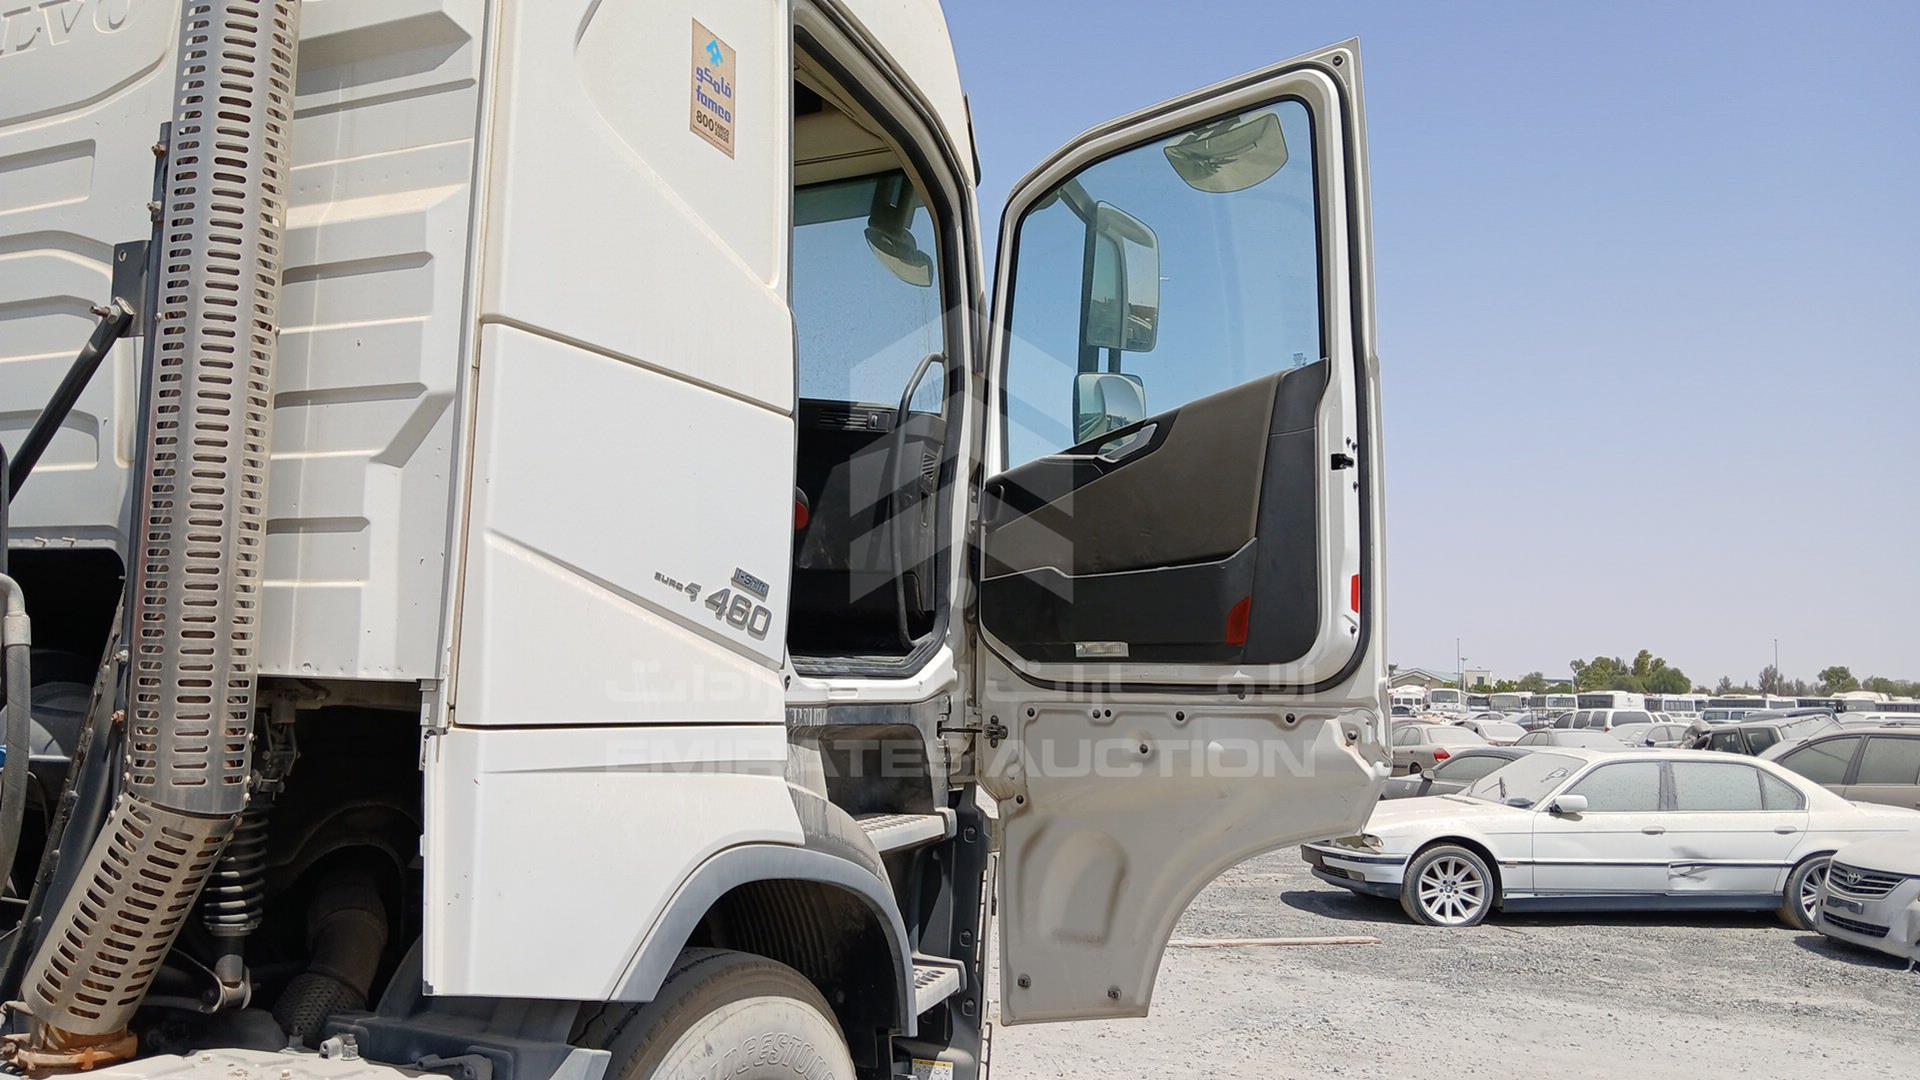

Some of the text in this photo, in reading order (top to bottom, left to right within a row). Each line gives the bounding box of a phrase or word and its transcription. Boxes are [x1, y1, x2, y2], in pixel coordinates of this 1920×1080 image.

[696, 84, 732, 123] famco
[696, 110, 714, 132] 800
[705, 588, 772, 641] 460
